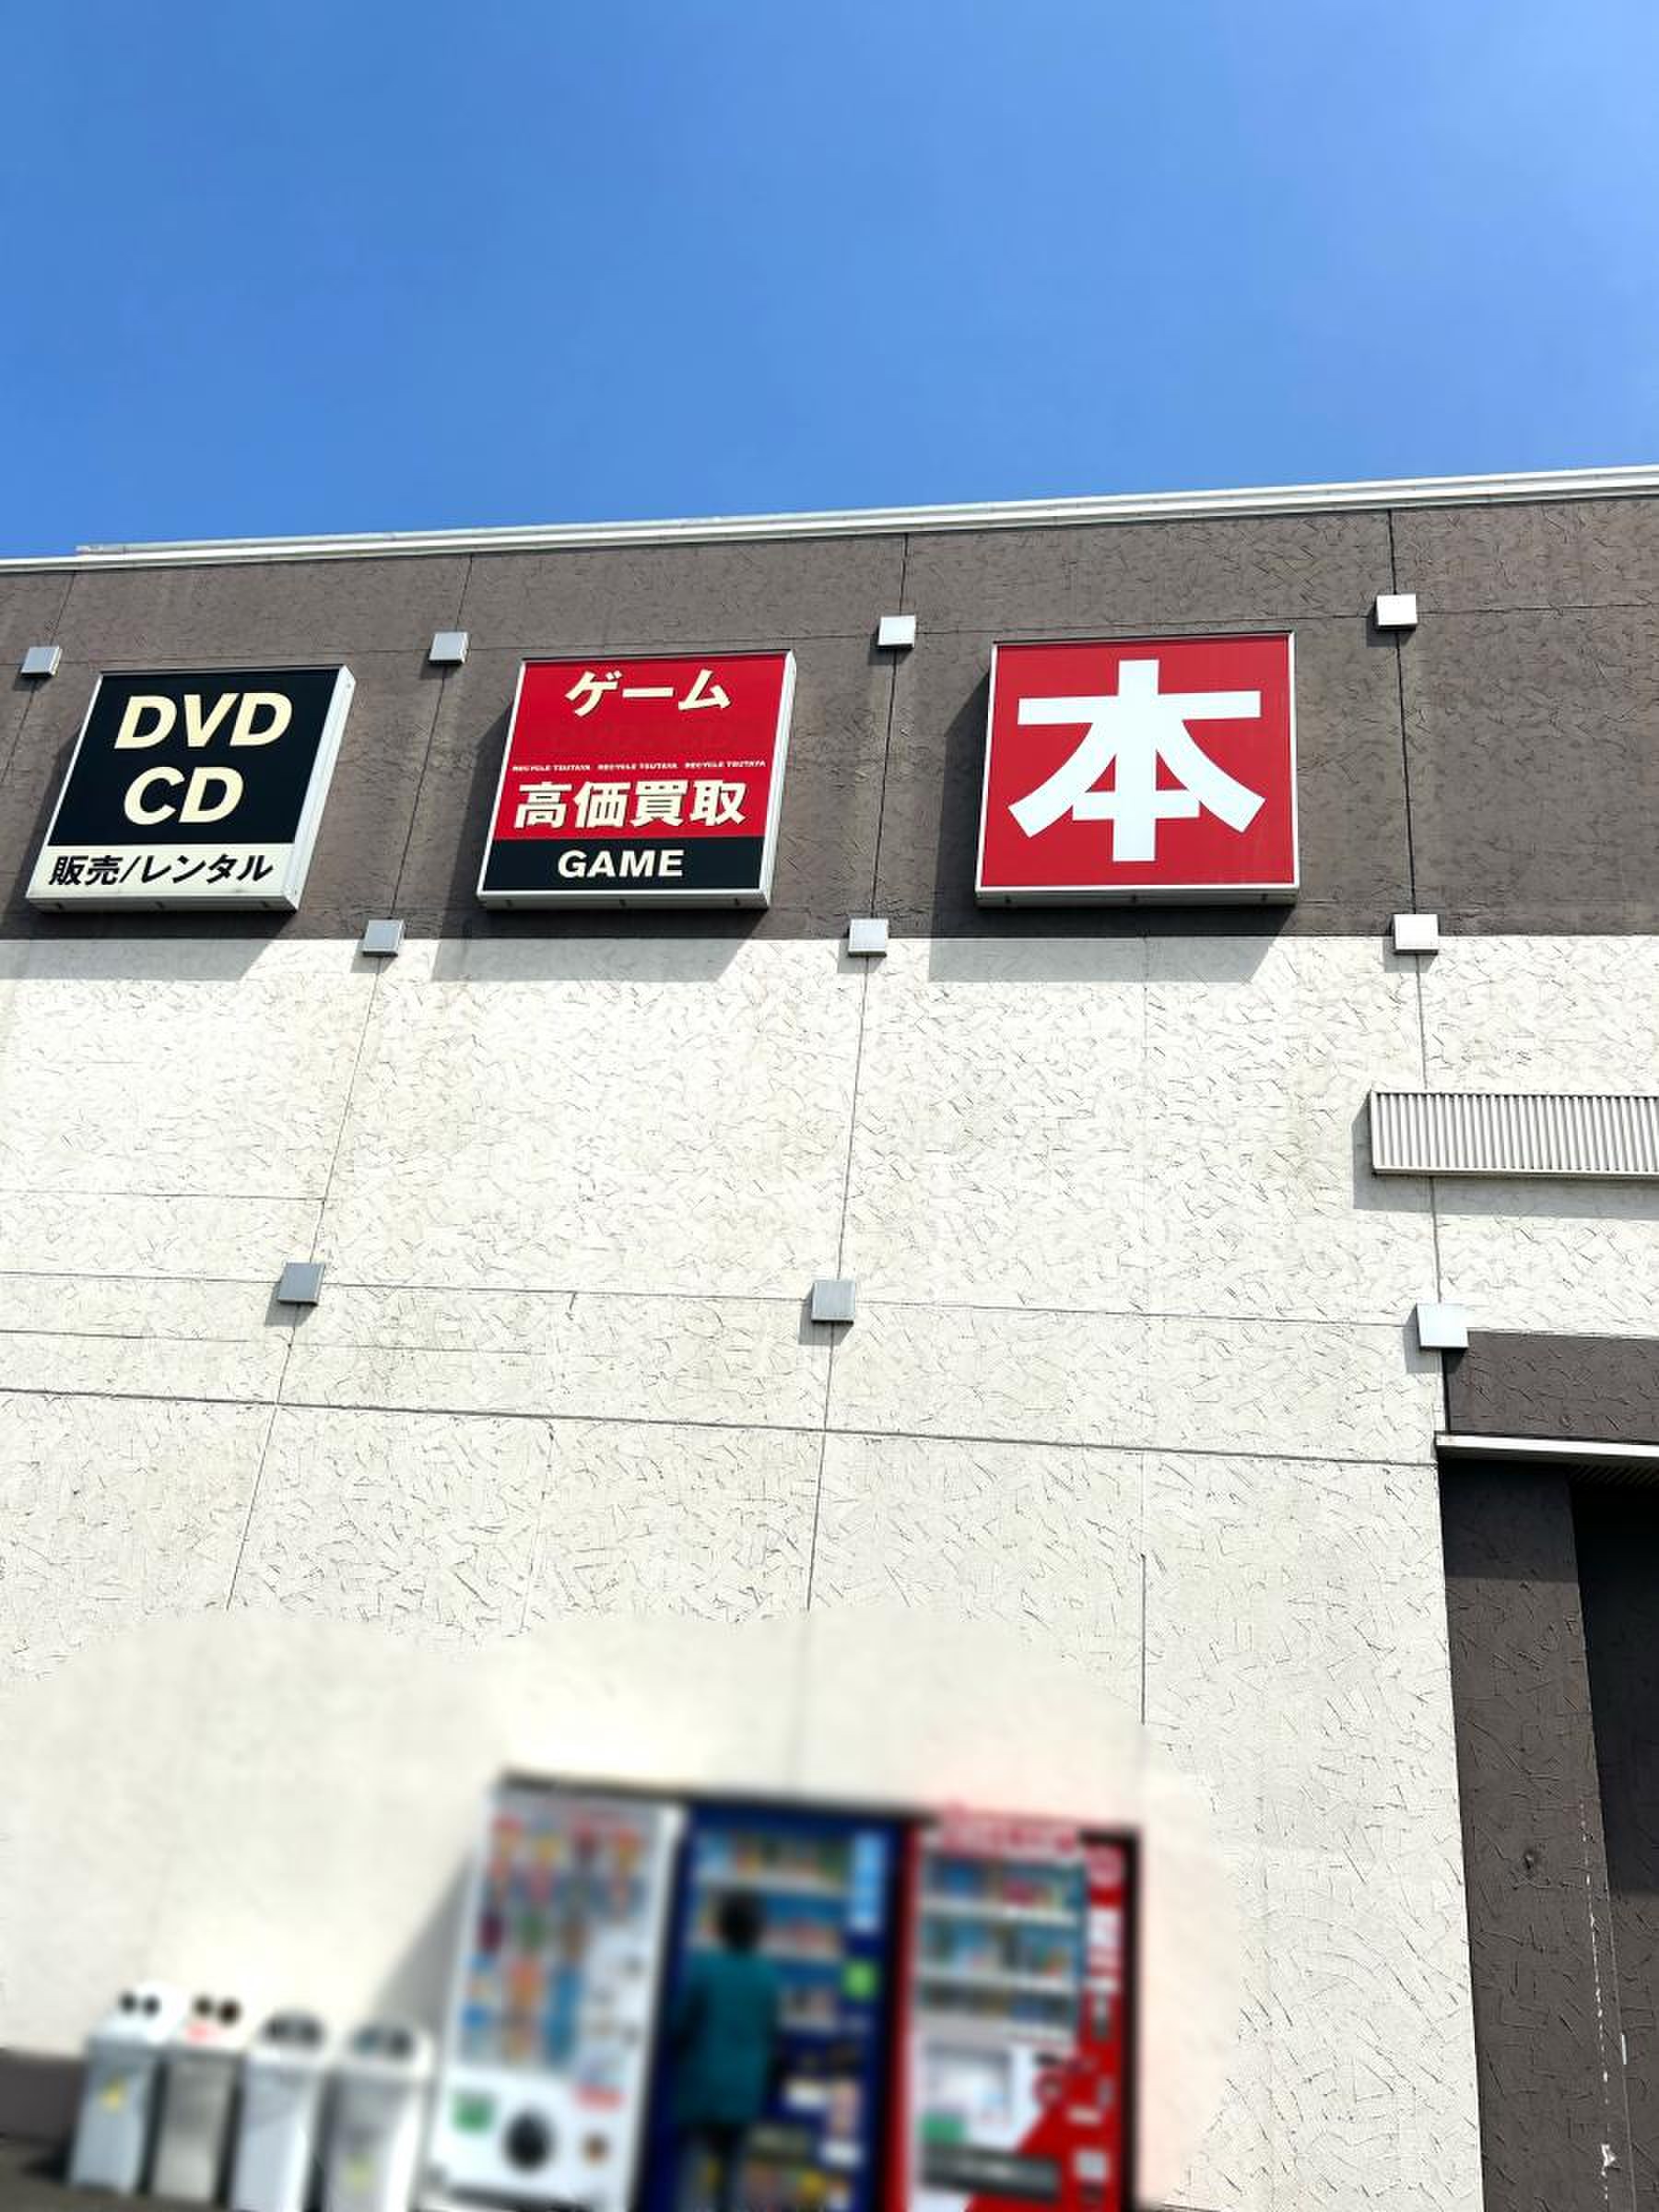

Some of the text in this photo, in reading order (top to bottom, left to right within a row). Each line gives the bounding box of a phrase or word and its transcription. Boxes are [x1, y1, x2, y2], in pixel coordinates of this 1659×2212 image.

[564, 669, 731, 717] ゲーム
[114, 692, 292, 749] DVD
[1008, 659, 1265, 862] 本
[124, 766, 243, 826] CD
[513, 780, 747, 829] 高価買取
[49, 854, 274, 886] 販売/レンタル
[558, 850, 684, 877] GAME
